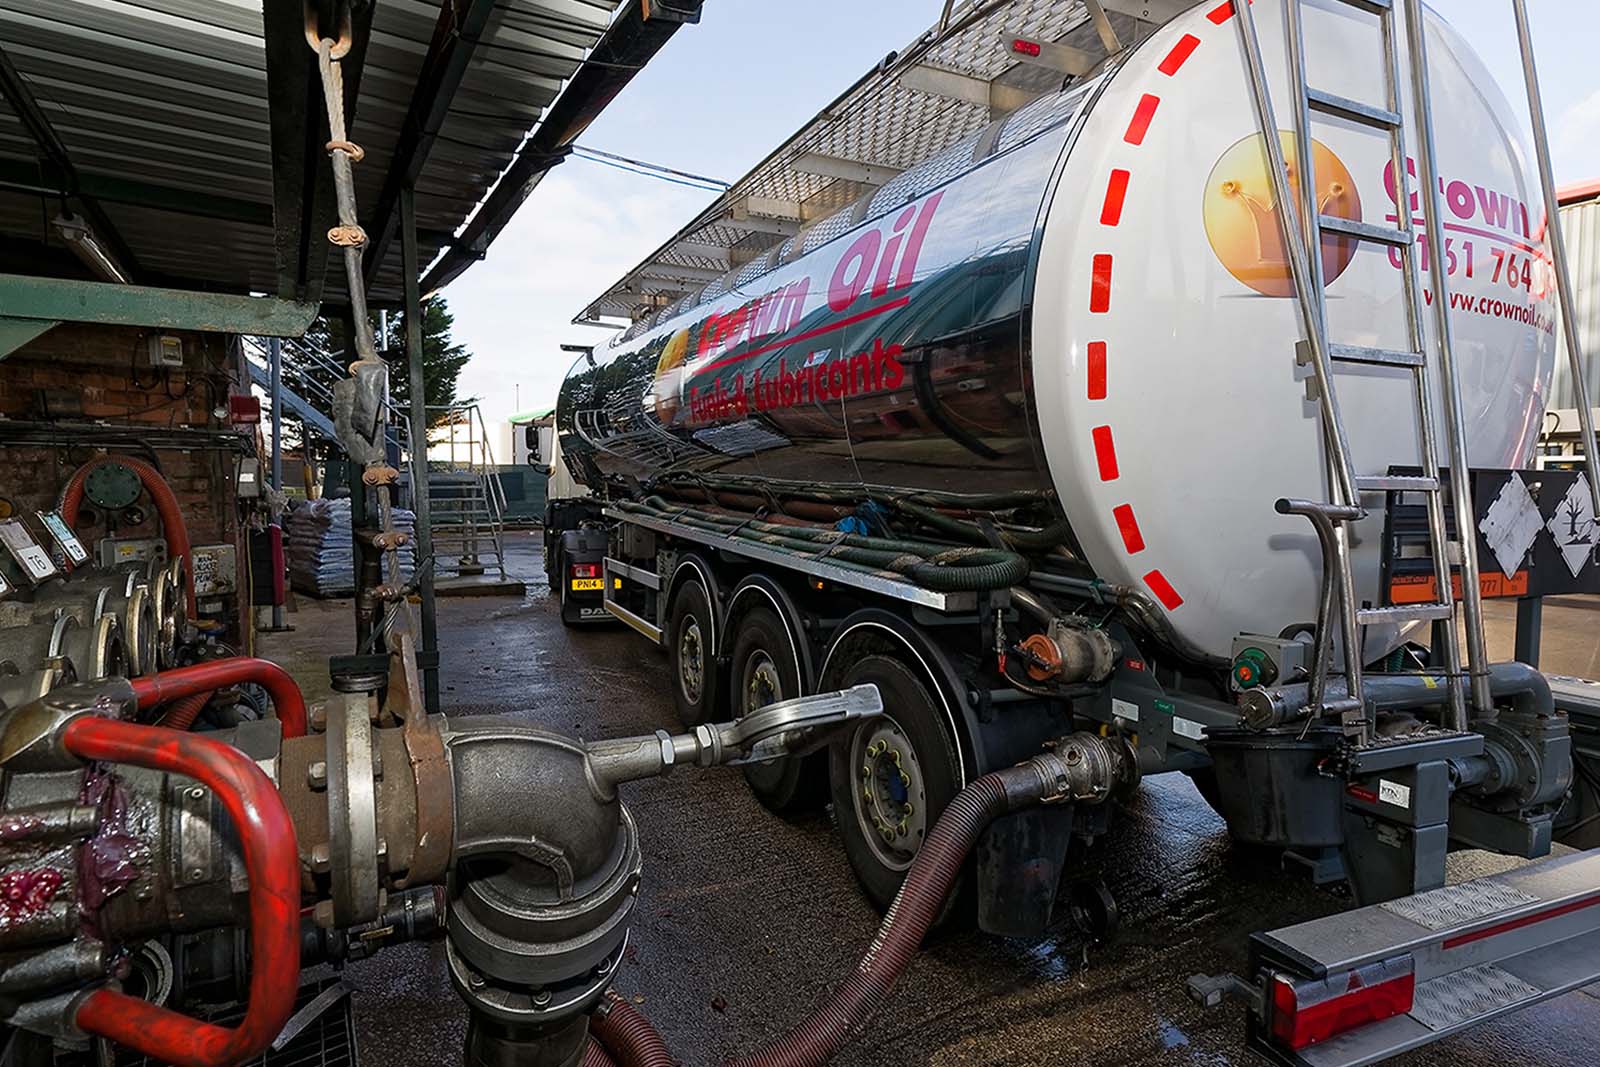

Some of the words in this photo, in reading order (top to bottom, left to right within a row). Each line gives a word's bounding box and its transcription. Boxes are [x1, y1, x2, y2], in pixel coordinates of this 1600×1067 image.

[1384, 156, 1530, 240] Cown
[1491, 247, 1532, 293] 764
[690, 376, 729, 423] Fuels
[732, 373, 749, 415] &
[752, 338, 906, 412] Lubricants
[28, 554, 47, 570] T6
[580, 607, 610, 616] DA
